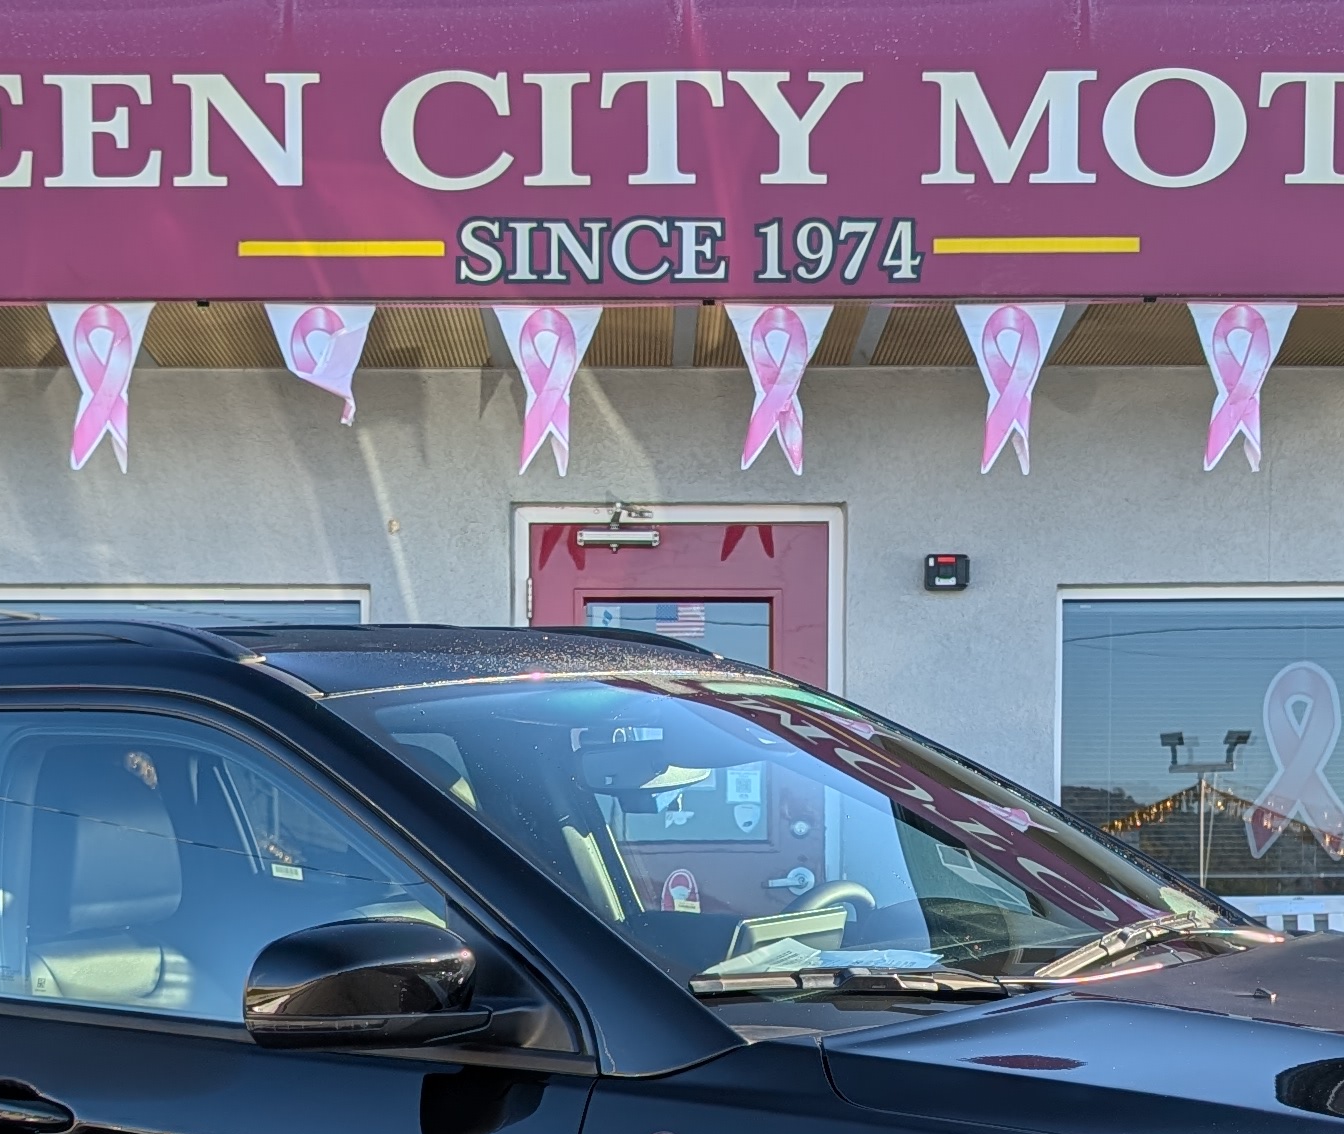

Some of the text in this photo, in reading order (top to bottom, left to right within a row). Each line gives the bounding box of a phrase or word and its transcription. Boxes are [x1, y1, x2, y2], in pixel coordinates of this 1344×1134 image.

[378, 68, 865, 192] CITY
[455, 214, 926, 286] SINCE 1974
